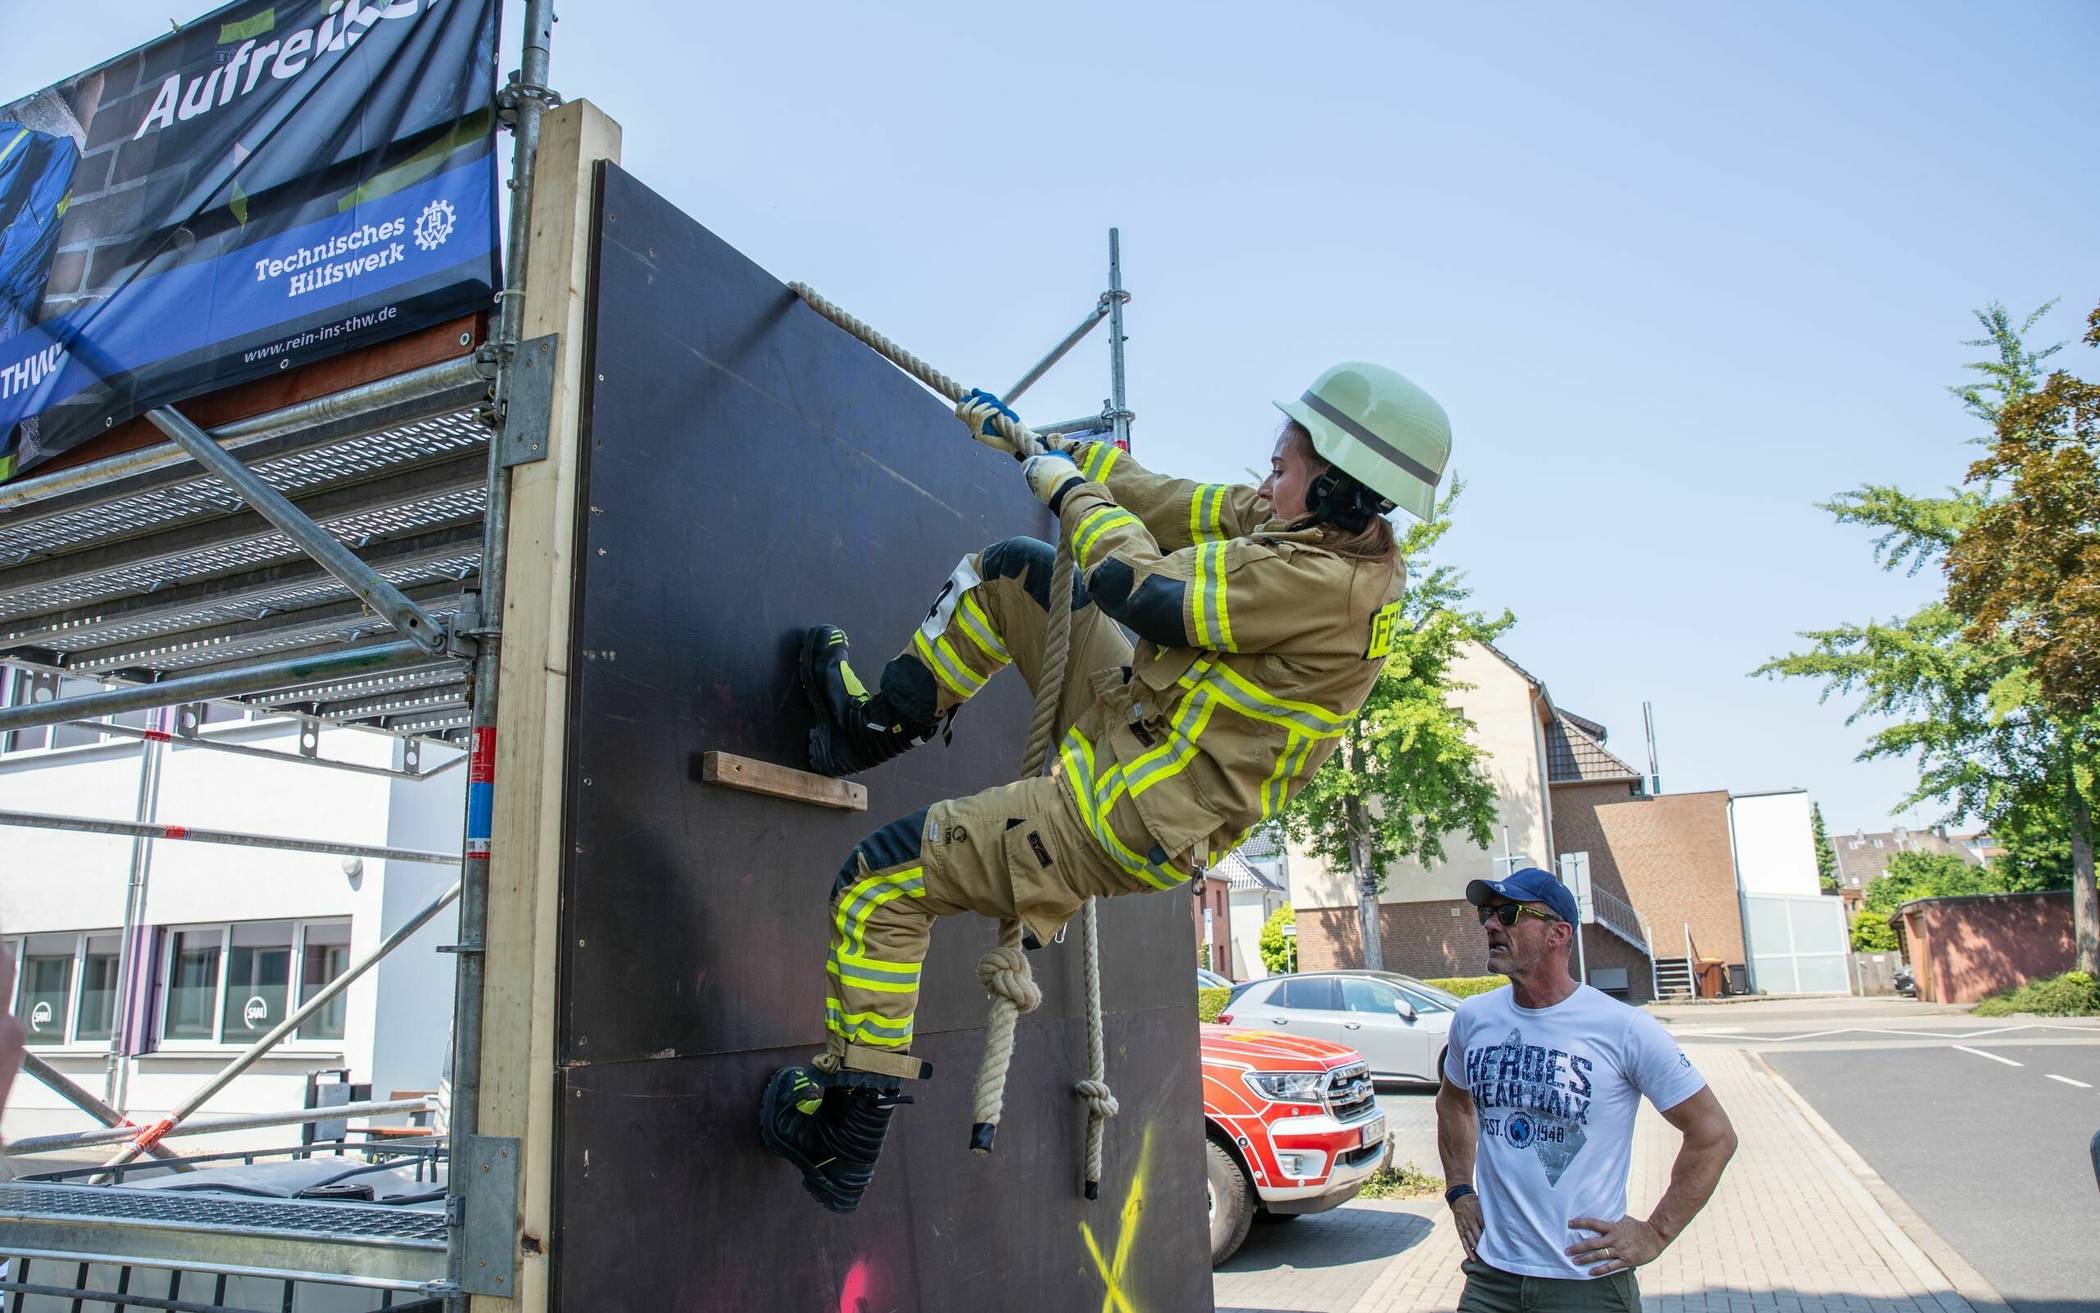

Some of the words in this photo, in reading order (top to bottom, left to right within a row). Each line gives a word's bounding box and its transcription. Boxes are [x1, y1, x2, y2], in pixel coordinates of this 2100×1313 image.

[255, 216, 405, 281] Technisches
[288, 242, 404, 297] Hilfswerk
[244, 305, 397, 363] www.rein-ins-thw.de
[1467, 1045, 1592, 1098] HEROES
[1536, 1123, 1564, 1143] 1948
